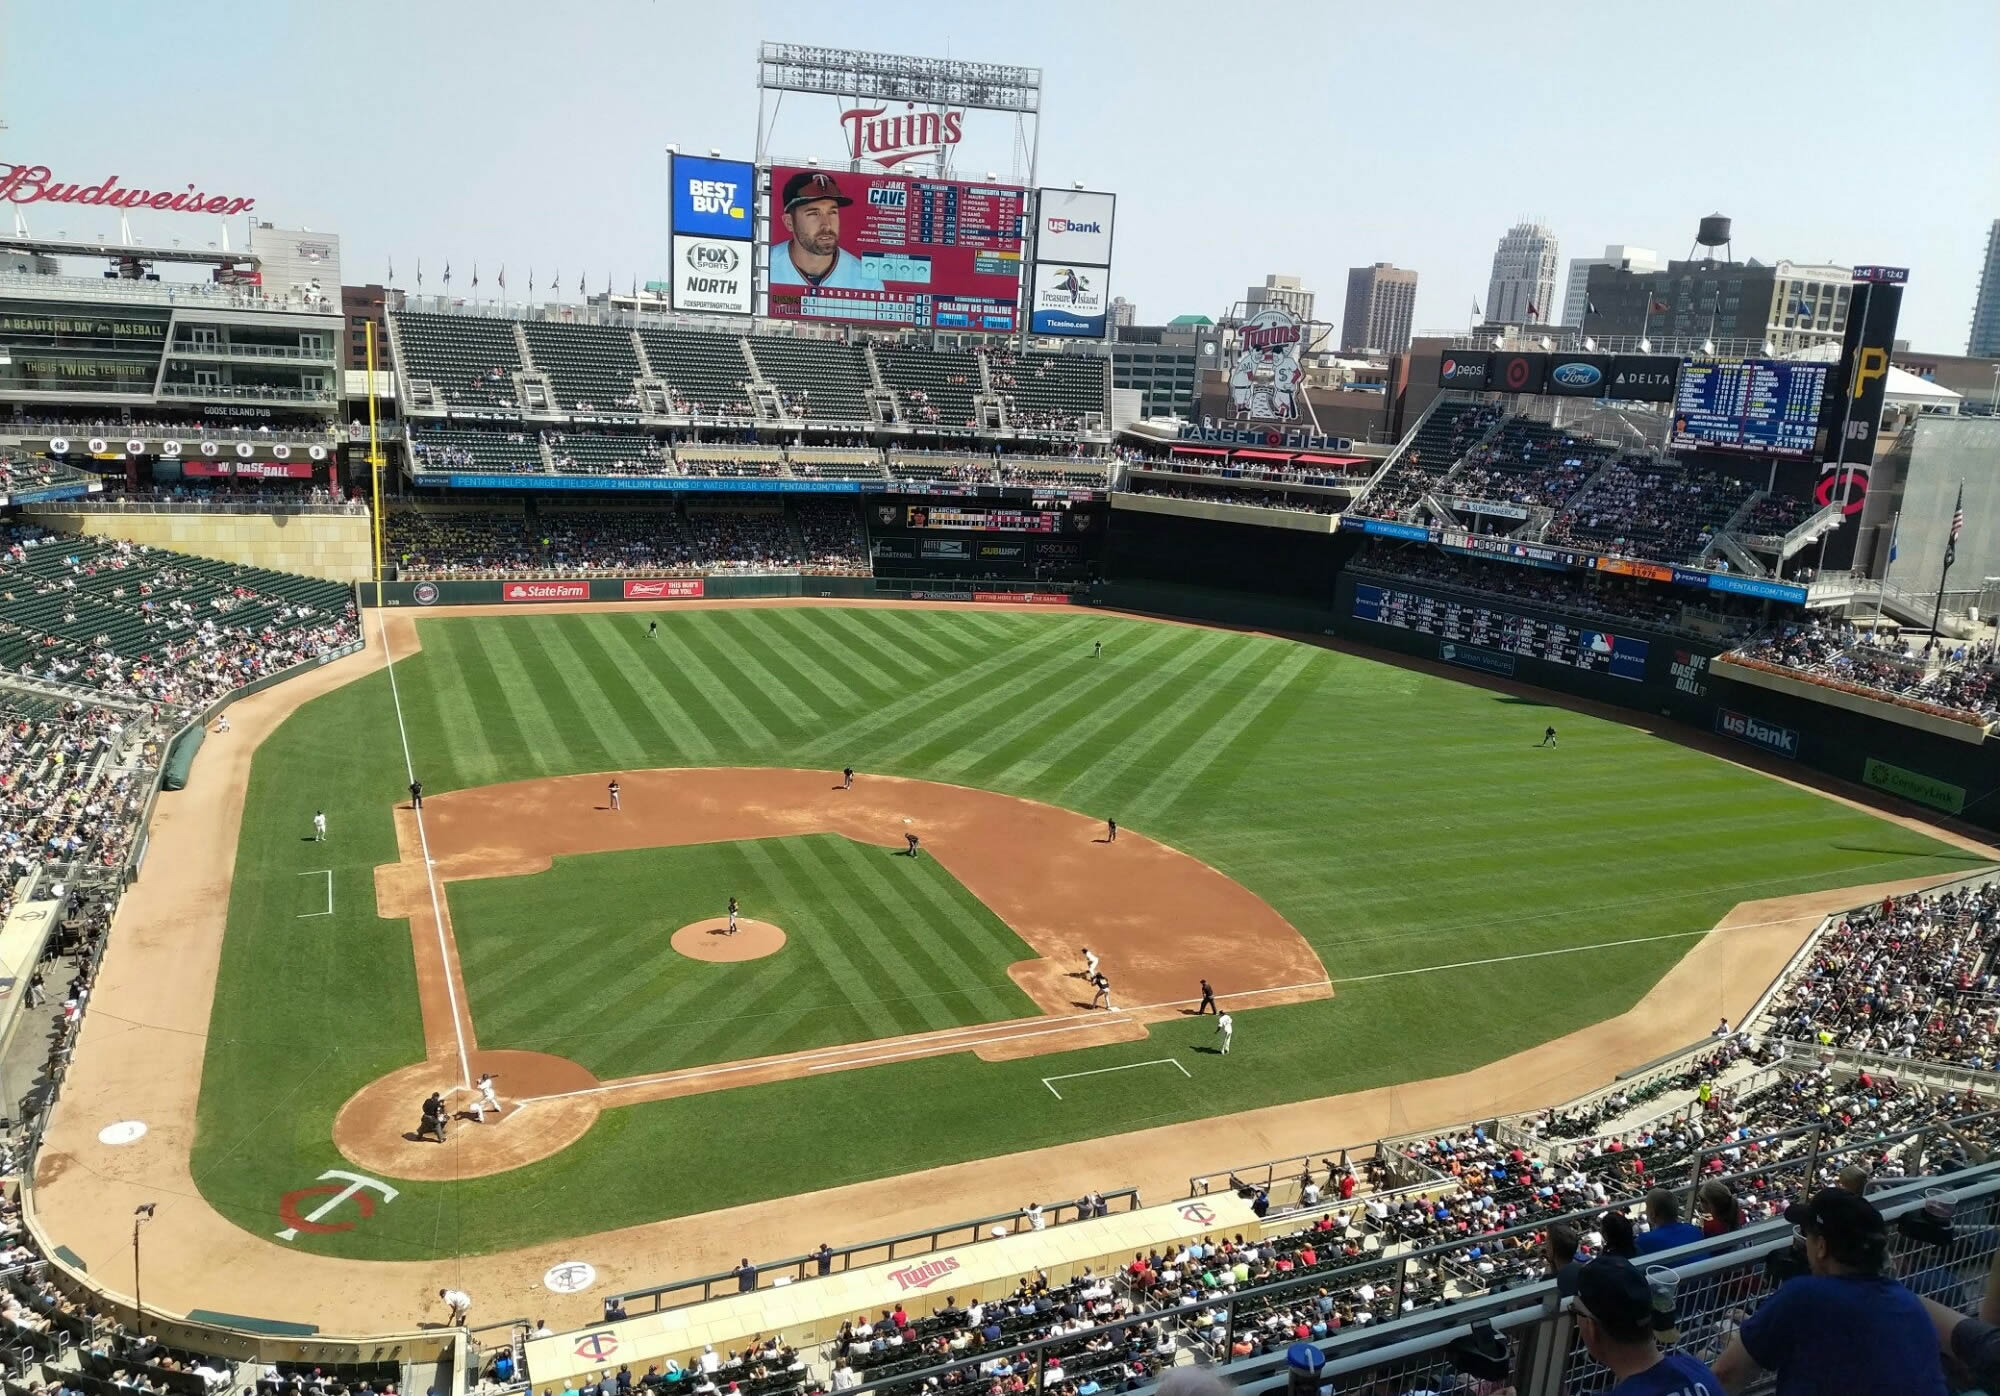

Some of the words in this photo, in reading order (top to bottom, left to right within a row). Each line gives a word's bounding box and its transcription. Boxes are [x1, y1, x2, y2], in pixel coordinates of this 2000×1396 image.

[840, 101, 962, 160] Twins
[0, 163, 255, 214] Budweiser
[689, 179, 737, 199] BEST
[885, 181, 906, 190] JAKE
[870, 189, 906, 206] CAVE
[693, 197, 734, 215] BUY
[697, 247, 728, 263] FOX
[697, 261, 729, 270] SPORTS
[1854, 269, 1871, 277] 12:42
[1887, 271, 1904, 279] 12:42
[686, 276, 738, 295] NORTH
[1041, 290, 1071, 303] Treasure
[1078, 293, 1099, 305] Island
[683, 299, 742, 311] FOXSPORTSNORTH.COM
[916, 306, 921, 314] S
[924, 306, 929, 314] 2
[939, 302, 969, 311] FOLLOW
[971, 304, 981, 312] US
[983, 305, 1012, 314] ONLINE
[4, 319, 10, 329] A
[14, 319, 71, 331] BEAUTIFUL
[75, 322, 92, 332] DAY
[97, 322, 109, 332] for
[114, 323, 163, 336] BASEBALL
[1238, 321, 1300, 352] Twins
[26, 362, 46, 372] THIS
[48, 363, 57, 372] IS
[60, 363, 96, 376] TWINS
[99, 364, 146, 375] TERRITORY
[1279, 368, 1288, 382] S
[1457, 364, 1485, 376] pepsi
[1561, 367, 1591, 384] Ford
[1848, 347, 1888, 398] P
[1629, 373, 1671, 385] DELTA
[204, 406, 227, 416] GOOSE
[228, 407, 255, 417] ISLAND
[256, 408, 271, 417] PUB
[1843, 420, 1869, 440] VS
[1178, 426, 1264, 444] TARGET
[1286, 433, 1351, 451] FIELD
[54, 442, 65, 450] 42
[93, 442, 102, 450] 10
[167, 444, 178, 452] 34
[218, 462, 231, 472] W
[458, 478, 496, 486] PENTAIR
[500, 479, 526, 487] HELPS
[528, 479, 561, 488] TARGET
[562, 480, 587, 488] FIELD
[618, 481, 651, 489] MILLION
[653, 481, 689, 489] GALLONS
[702, 482, 729, 490] WATER
[760, 483, 778, 491] VISIT
[780, 483, 854, 492] PENTAIR.COM/TWINS
[1472, 503, 1520, 517] SUPERAMERICA
[981, 547, 1021, 555] SUBWAY
[1464, 550, 1498, 559] TREASURE
[1500, 553, 1519, 562] ISLAND
[1522, 558, 1539, 567] COVE
[1567, 555, 1573, 564] 6
[1578, 556, 1585, 567] P
[1588, 558, 1595, 567] 6
[1681, 575, 1707, 583] PENTAIR
[528, 587, 556, 597] State
[557, 586, 584, 597] Farm
[632, 585, 663, 593] Budweiser
[1728, 582, 1803, 600] PENTAIR.COM/TWINS
[1462, 651, 1481, 662] Urban
[1483, 656, 1512, 670] Ventures
[1620, 655, 1645, 663] PENTAIR
[1689, 653, 1706, 670] WE
[1670, 663, 1696, 679] BASE
[1675, 677, 1700, 695] BALL
[1892, 775, 1953, 803] CenturyLink
[887, 1256, 960, 1290] Twins
